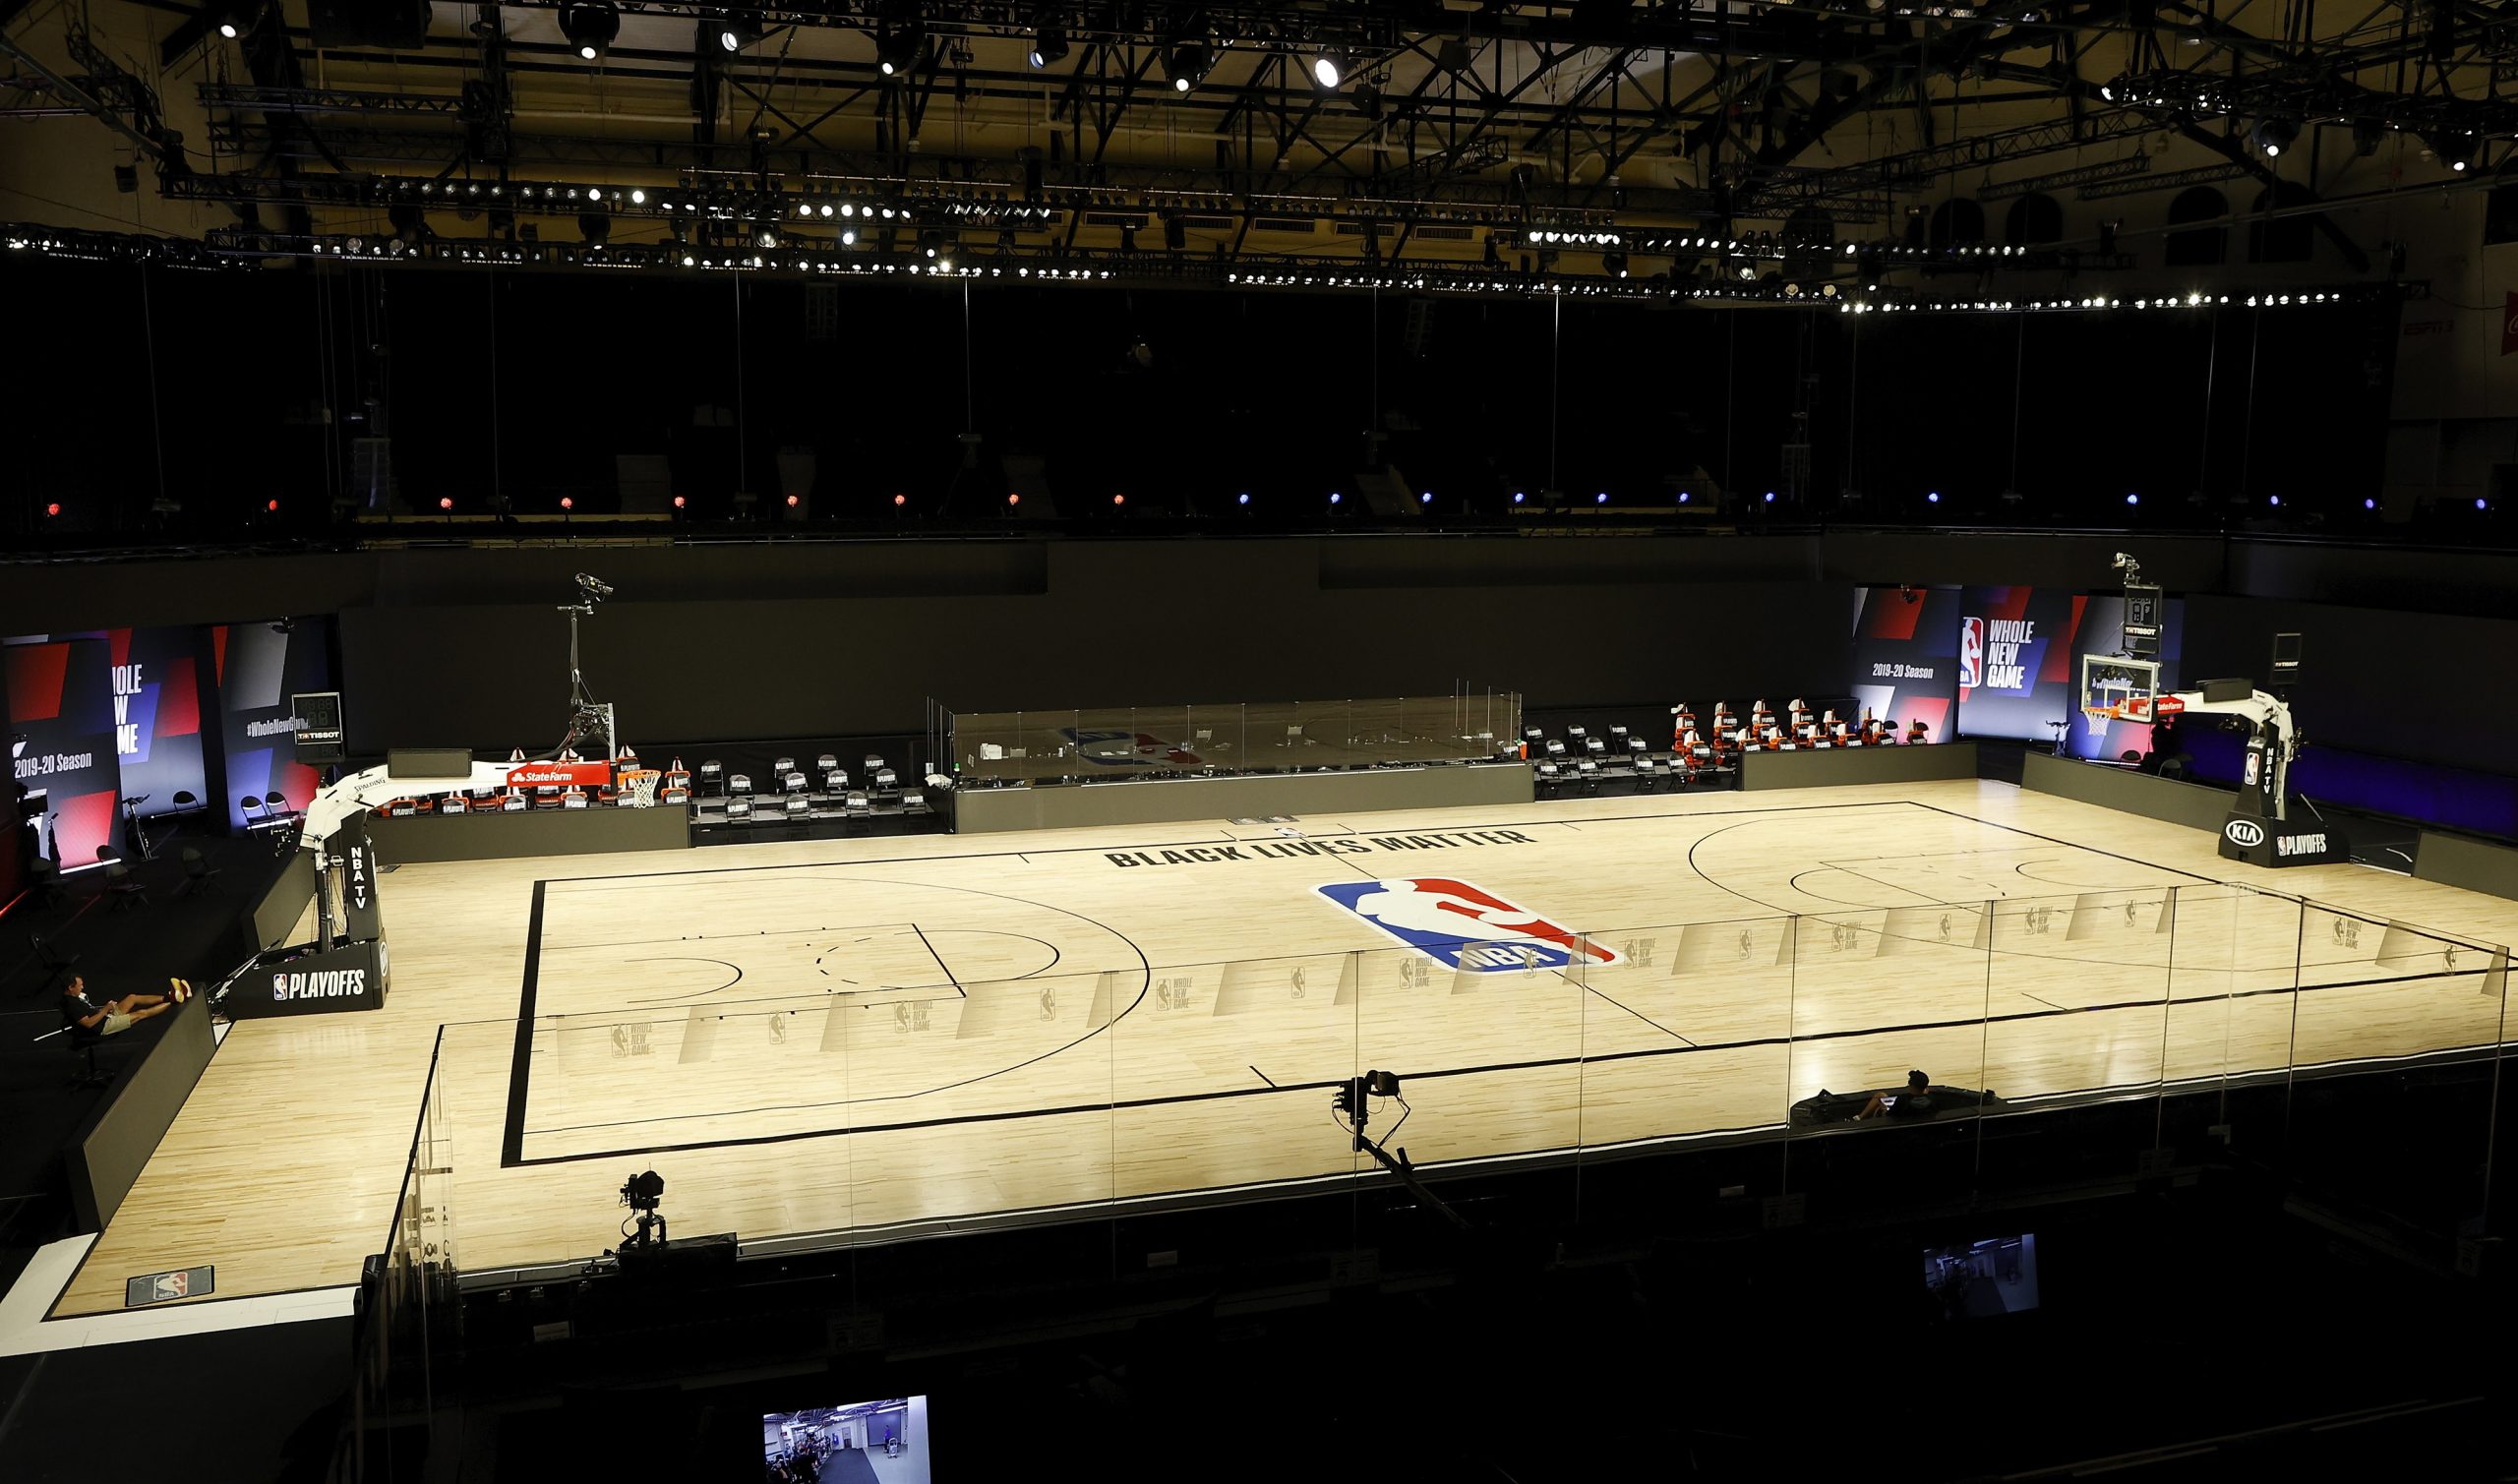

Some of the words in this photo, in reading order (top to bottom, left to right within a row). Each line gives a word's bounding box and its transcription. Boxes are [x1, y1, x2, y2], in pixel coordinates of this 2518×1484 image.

[1989, 620, 2035, 644] WHOLE
[1988, 642, 2020, 666] NEW
[1872, 663, 1905, 678] 2019-20
[1904, 664, 1934, 679] Season
[1987, 665, 2026, 689] GAME
[2157, 702, 2183, 711] tateFarm
[310, 731, 340, 740] TISSOT
[15, 754, 55, 779] 2019-20
[56, 752, 92, 773] Season
[2264, 747, 2274, 774] NBA
[2263, 776, 2272, 795] TV
[2232, 824, 2257, 843] KIA
[2286, 833, 2327, 856] PLAYOFFS
[1105, 844, 1251, 868] BLACK
[1251, 836, 1372, 860] LIVES
[1367, 828, 1539, 853] MATTER
[350, 847, 365, 882] NBA
[354, 886, 367, 909] TV
[1449, 945, 1557, 969] NBA
[289, 969, 365, 999] PLAYOFFS
